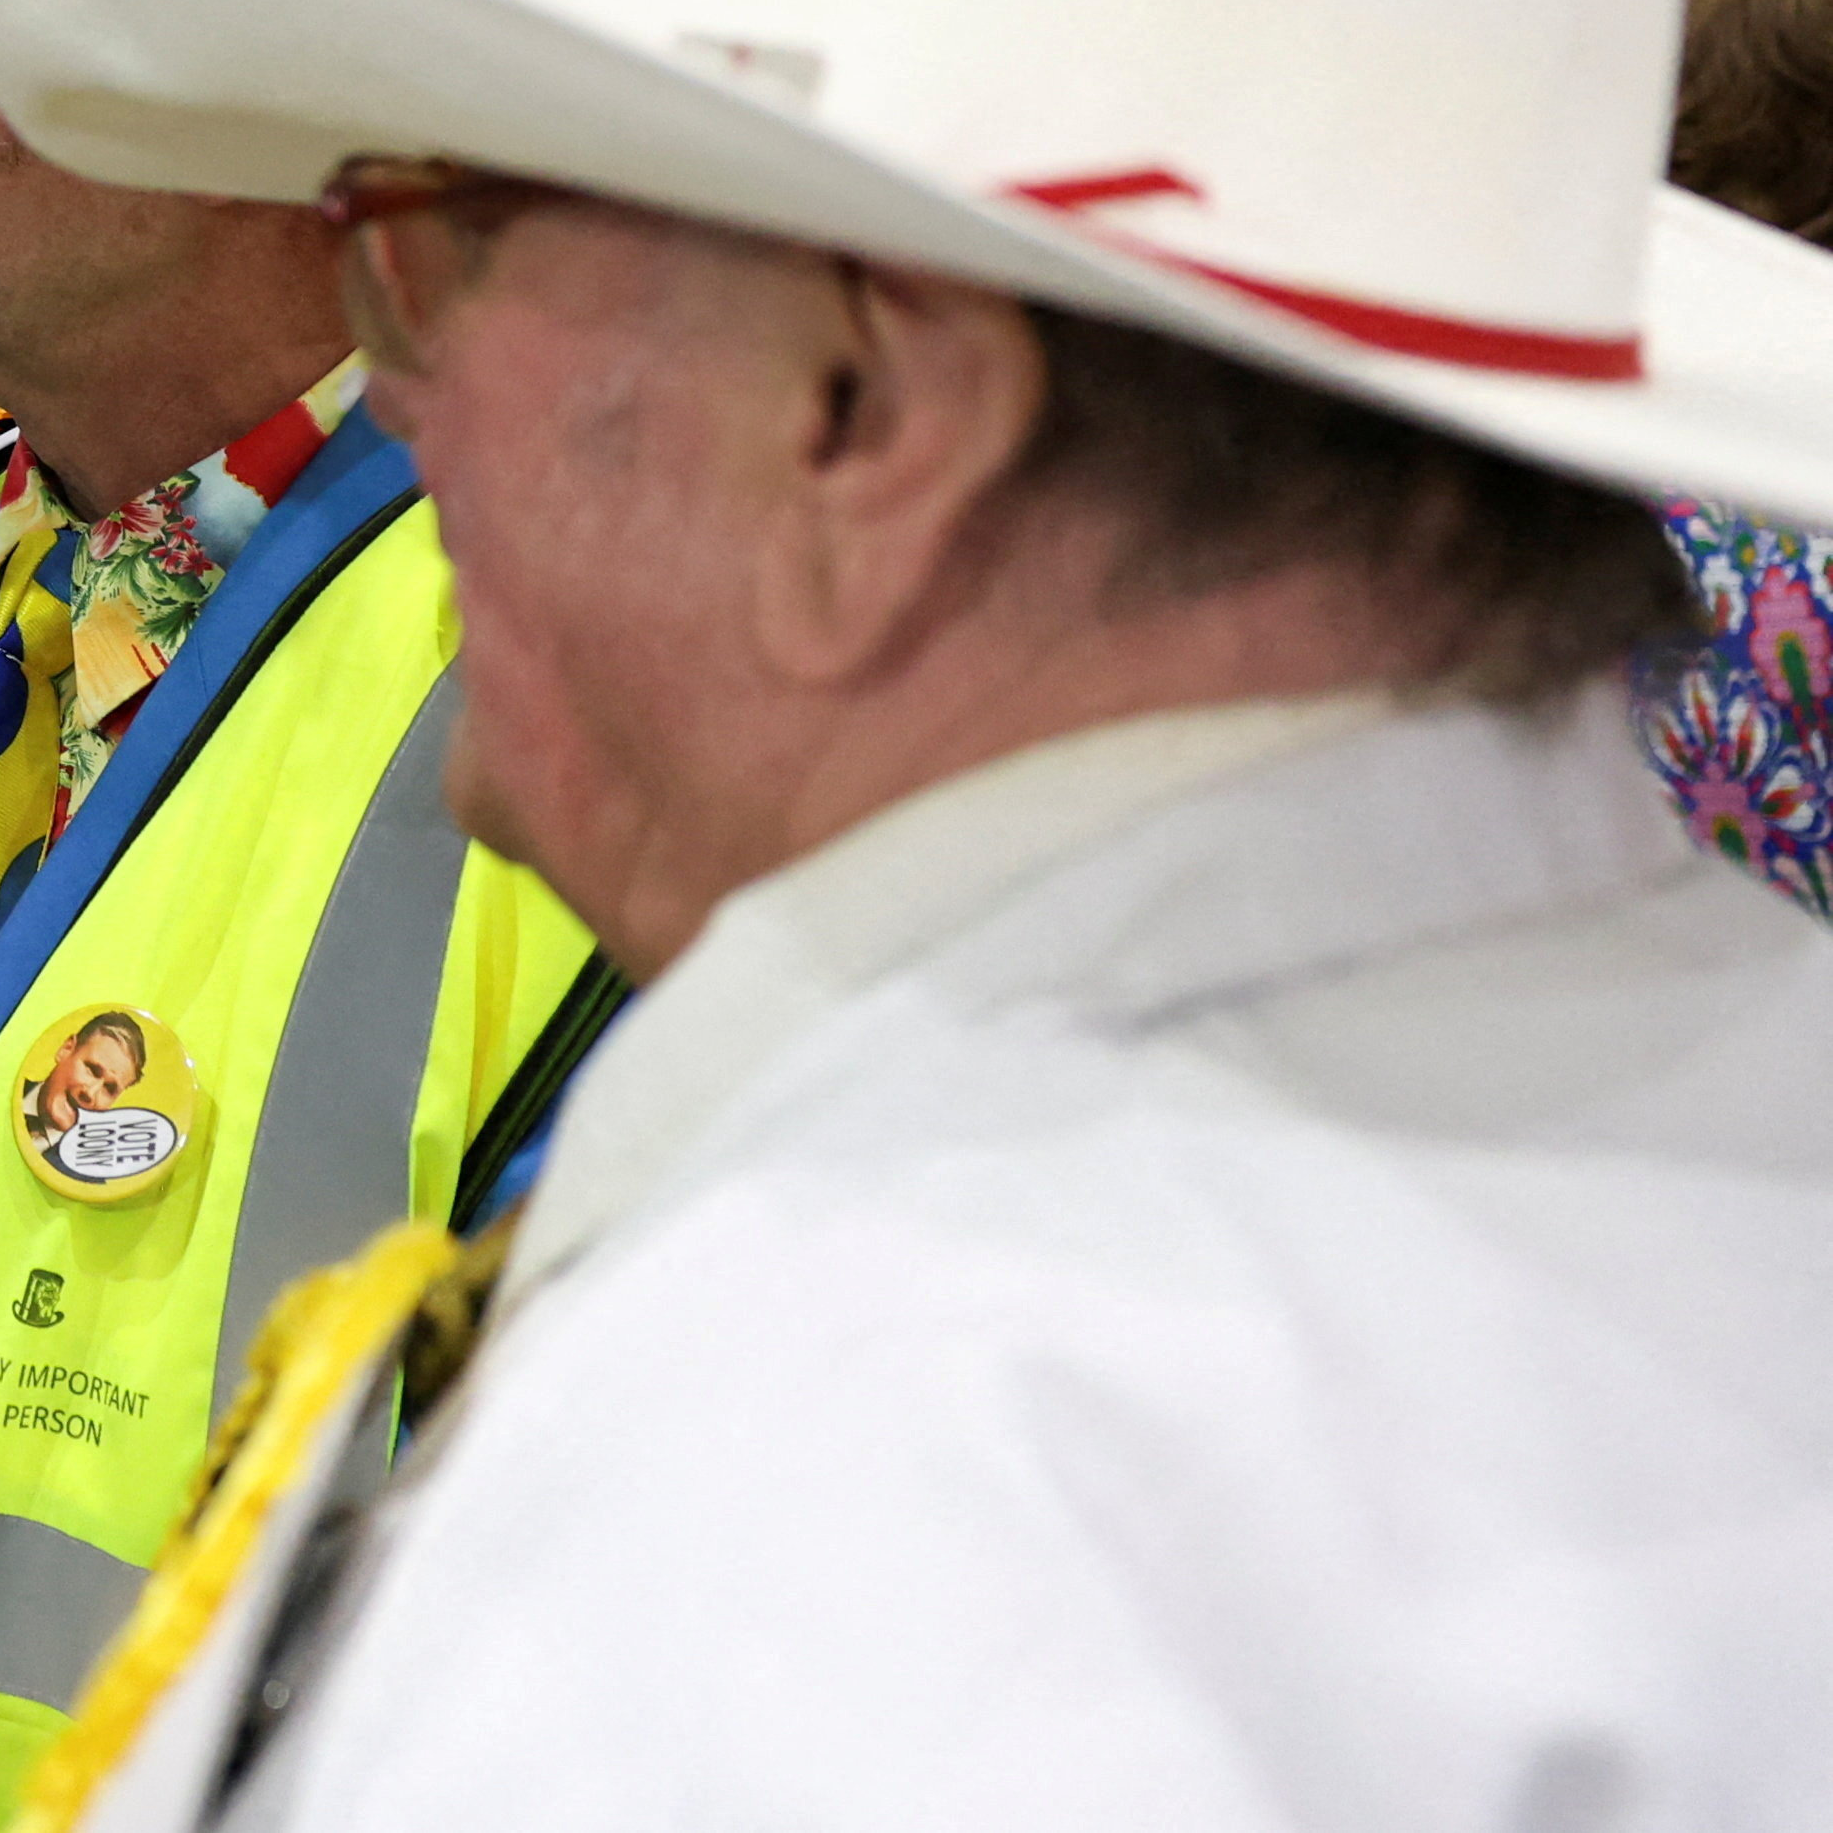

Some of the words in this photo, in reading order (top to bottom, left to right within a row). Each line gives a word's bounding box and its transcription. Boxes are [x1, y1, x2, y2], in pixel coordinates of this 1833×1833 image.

[75, 1120, 117, 1167] LOONY
[116, 1118, 158, 1164] VOTE
[18, 1364, 150, 1419] IMPORTANT
[3, 1404, 103, 1447] PERSON
